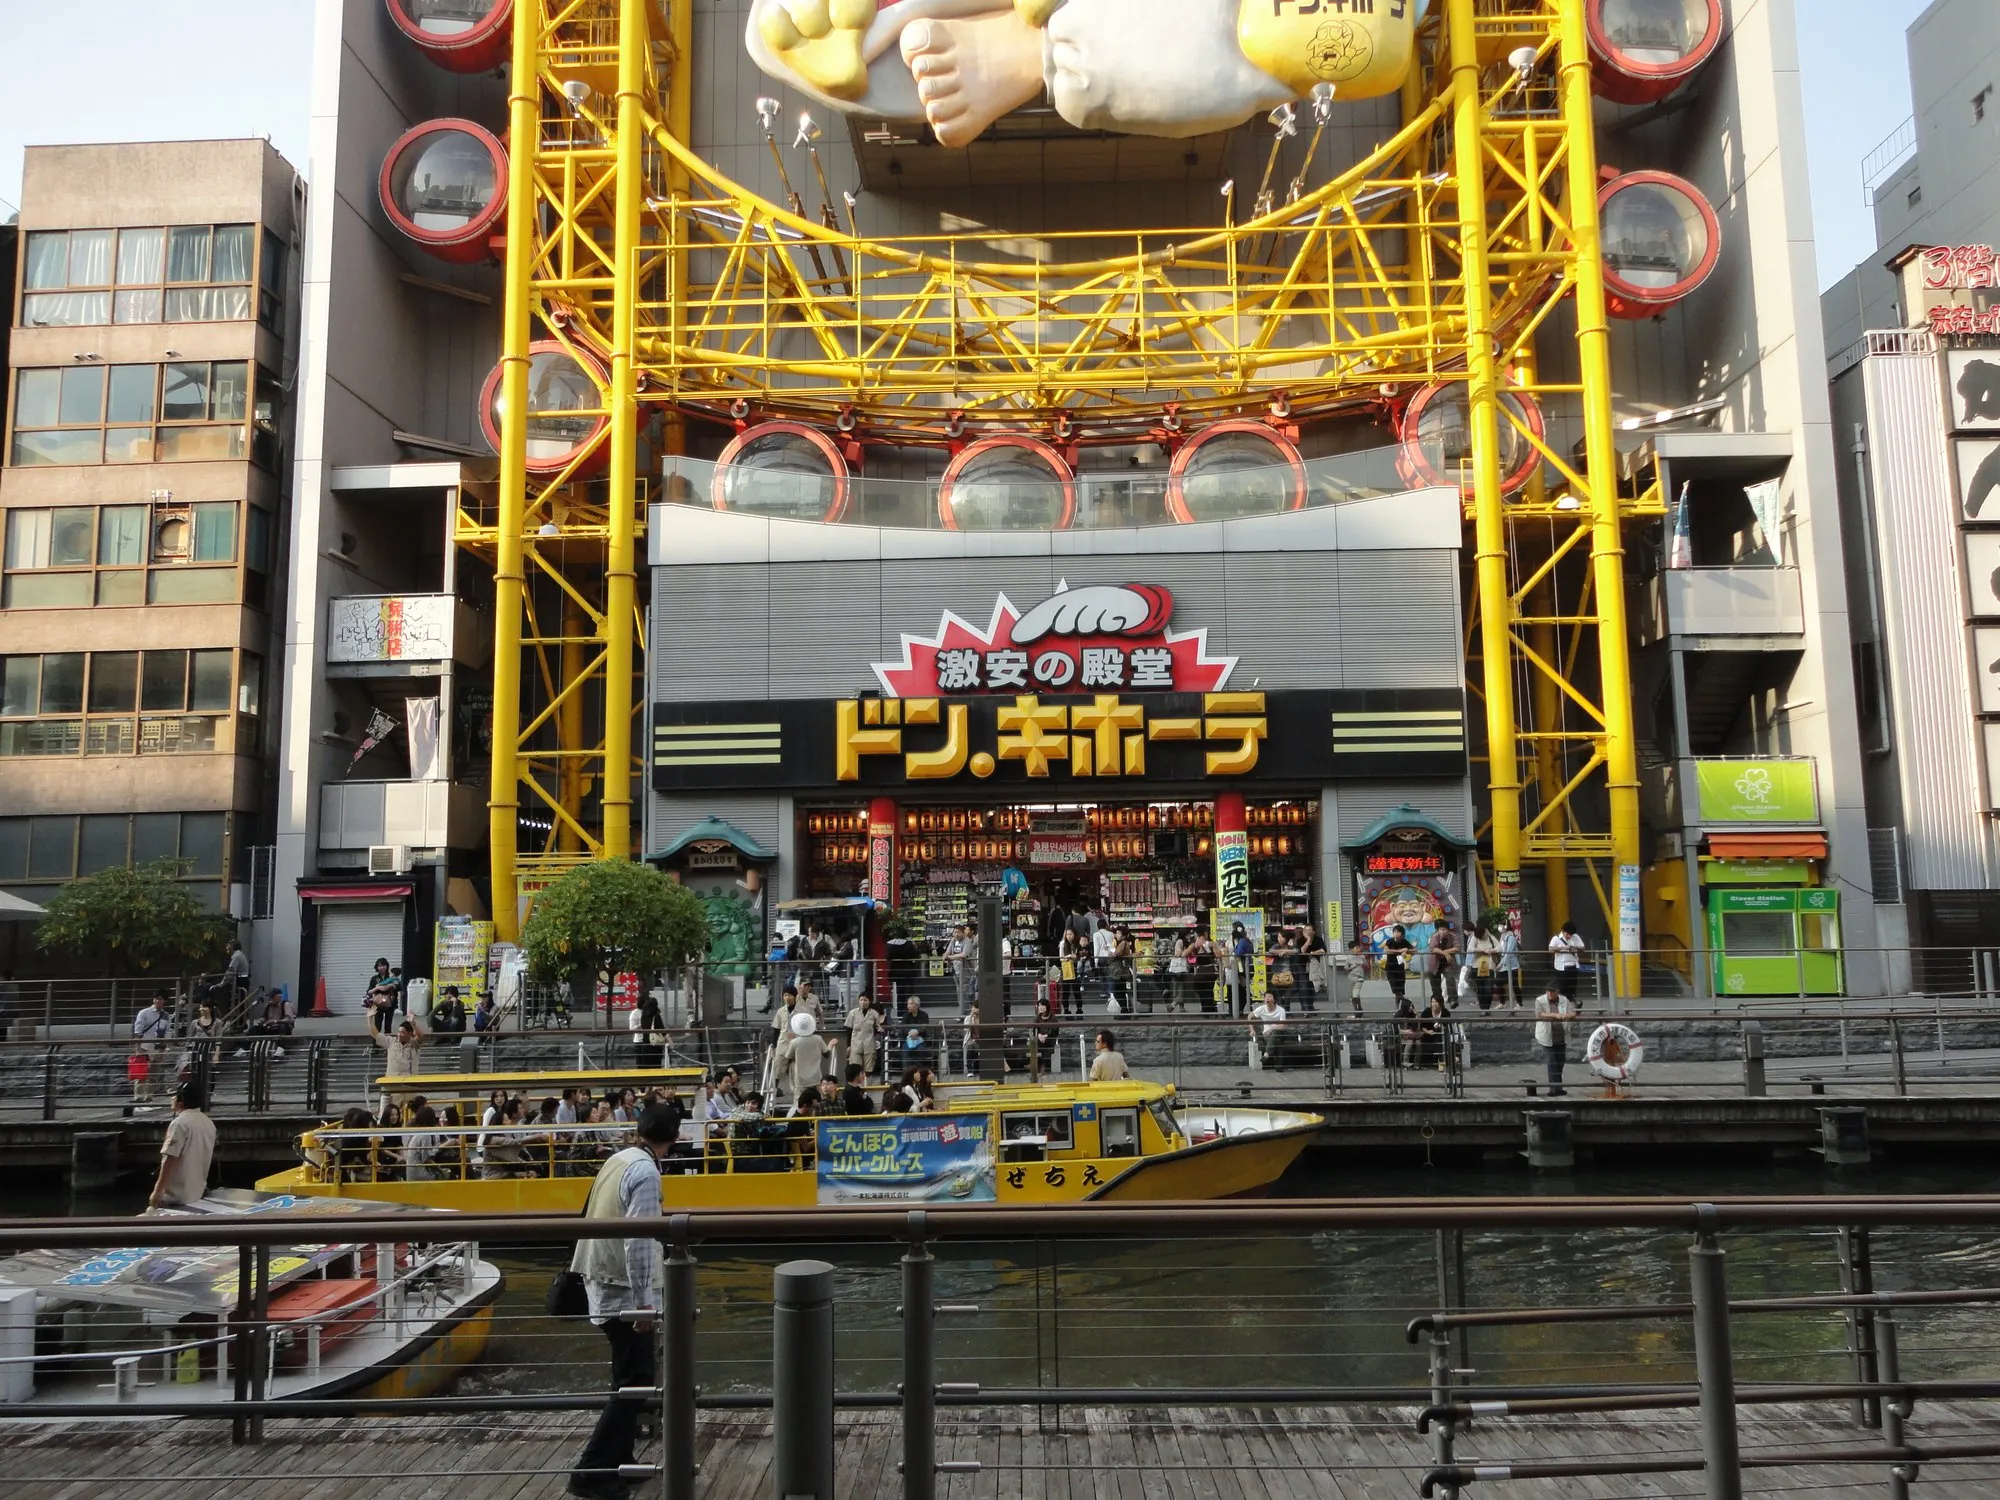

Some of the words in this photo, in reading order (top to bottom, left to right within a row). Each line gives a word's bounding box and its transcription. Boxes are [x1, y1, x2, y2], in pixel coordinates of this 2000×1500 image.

[387, 600, 403, 657] 免税店
[936, 647, 1174, 689] 激安の殿堂
[1063, 853, 1082, 862] 5%
[1368, 857, 1441, 870] 謹賀新年
